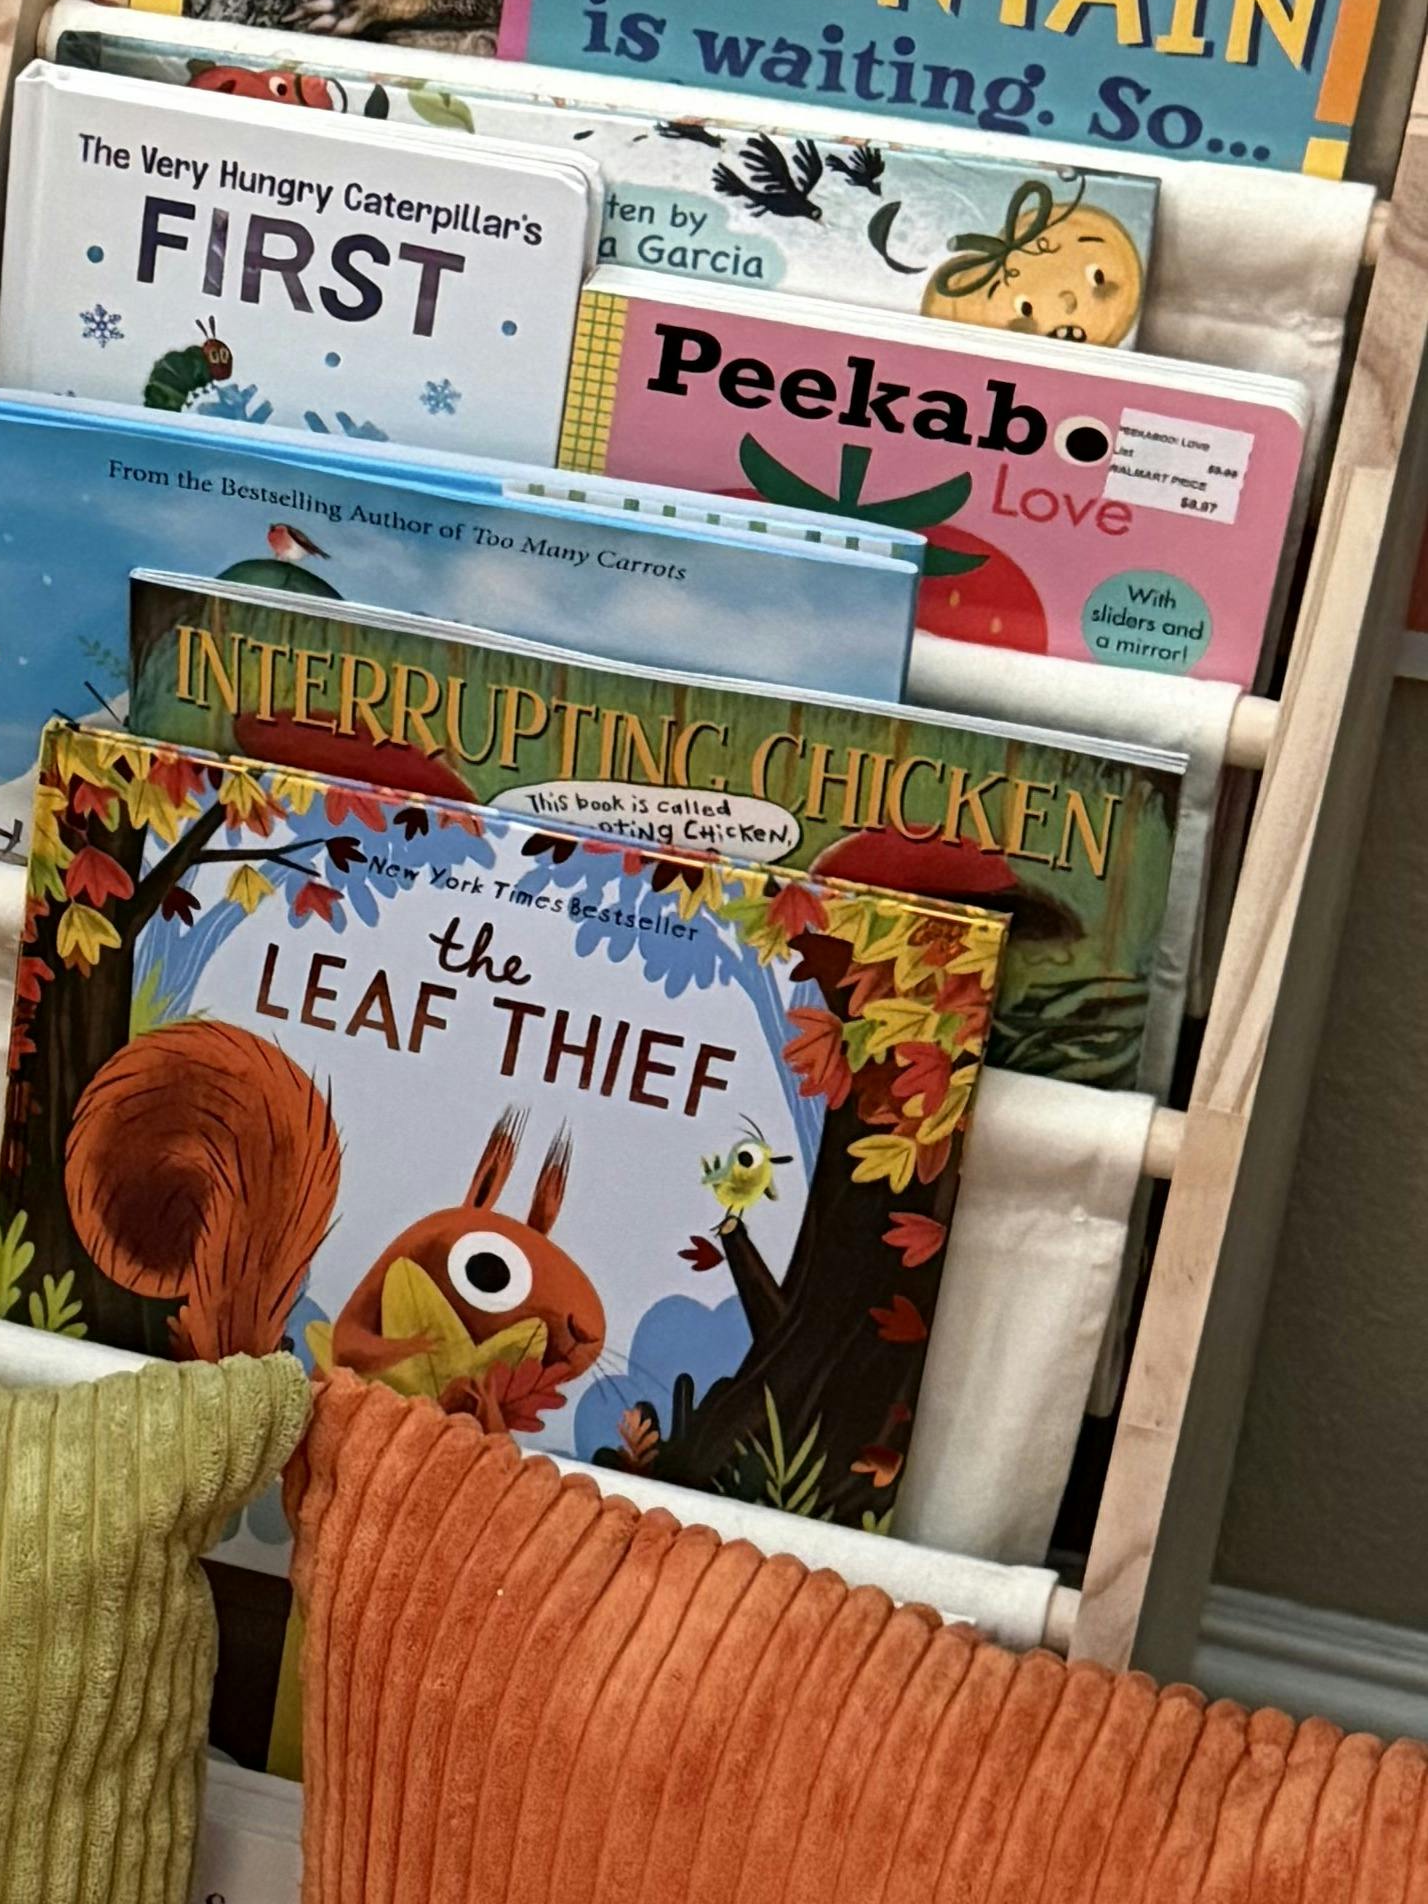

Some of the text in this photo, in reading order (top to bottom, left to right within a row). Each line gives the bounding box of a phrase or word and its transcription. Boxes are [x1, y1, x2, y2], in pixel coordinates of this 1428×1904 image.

[691, 23, 1056, 138] waiting.
[1086, 75, 1272, 164] So...
[78, 132, 543, 247] The Very Hungry Caterpillar's
[605, 192, 708, 237] ten by
[135, 194, 466, 338] FIRST
[598, 234, 764, 279] a Garcia
[108, 458, 688, 582] From the Bestselling Author of Too Many Carrots
[992, 463, 1134, 537] Love
[1171, 476, 1208, 492] PRICE
[1091, 604, 1204, 641] sliders and
[1128, 583, 1177, 610] With
[1095, 635, 1188, 664] a mirror!
[175, 623, 1124, 880] INTERRUPTING CHICKEN
[526, 791, 731, 817] This book is called
[368, 856, 699, 941] New York Times Bestseller
[428, 916, 532, 986] the
[255, 942, 737, 1118] LEAF THIEF
